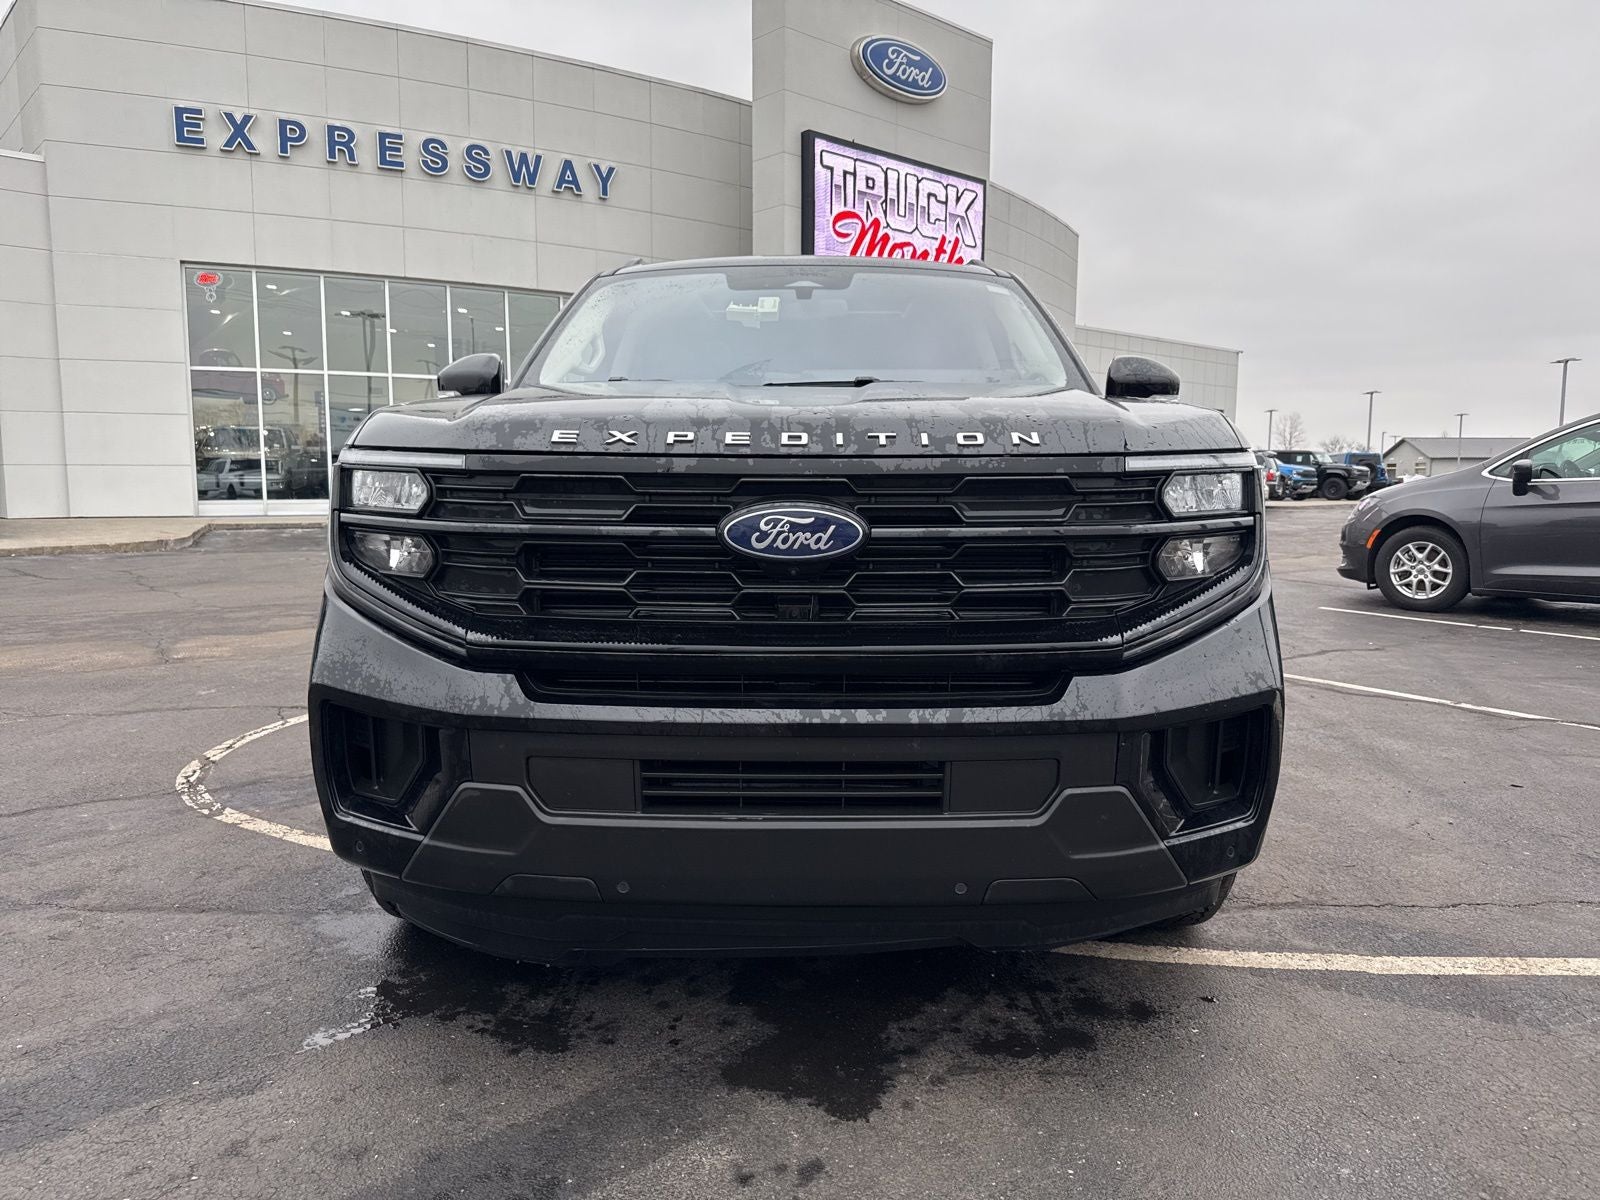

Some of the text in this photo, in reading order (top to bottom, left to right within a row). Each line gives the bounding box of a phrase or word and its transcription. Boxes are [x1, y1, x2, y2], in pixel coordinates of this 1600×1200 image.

[882, 46, 932, 88] Ford
[172, 104, 617, 199] EXPRESSWAY
[820, 150, 978, 248] TRUCK
[550, 429, 1042, 446] EXPEDITION
[750, 515, 836, 551] Ford
